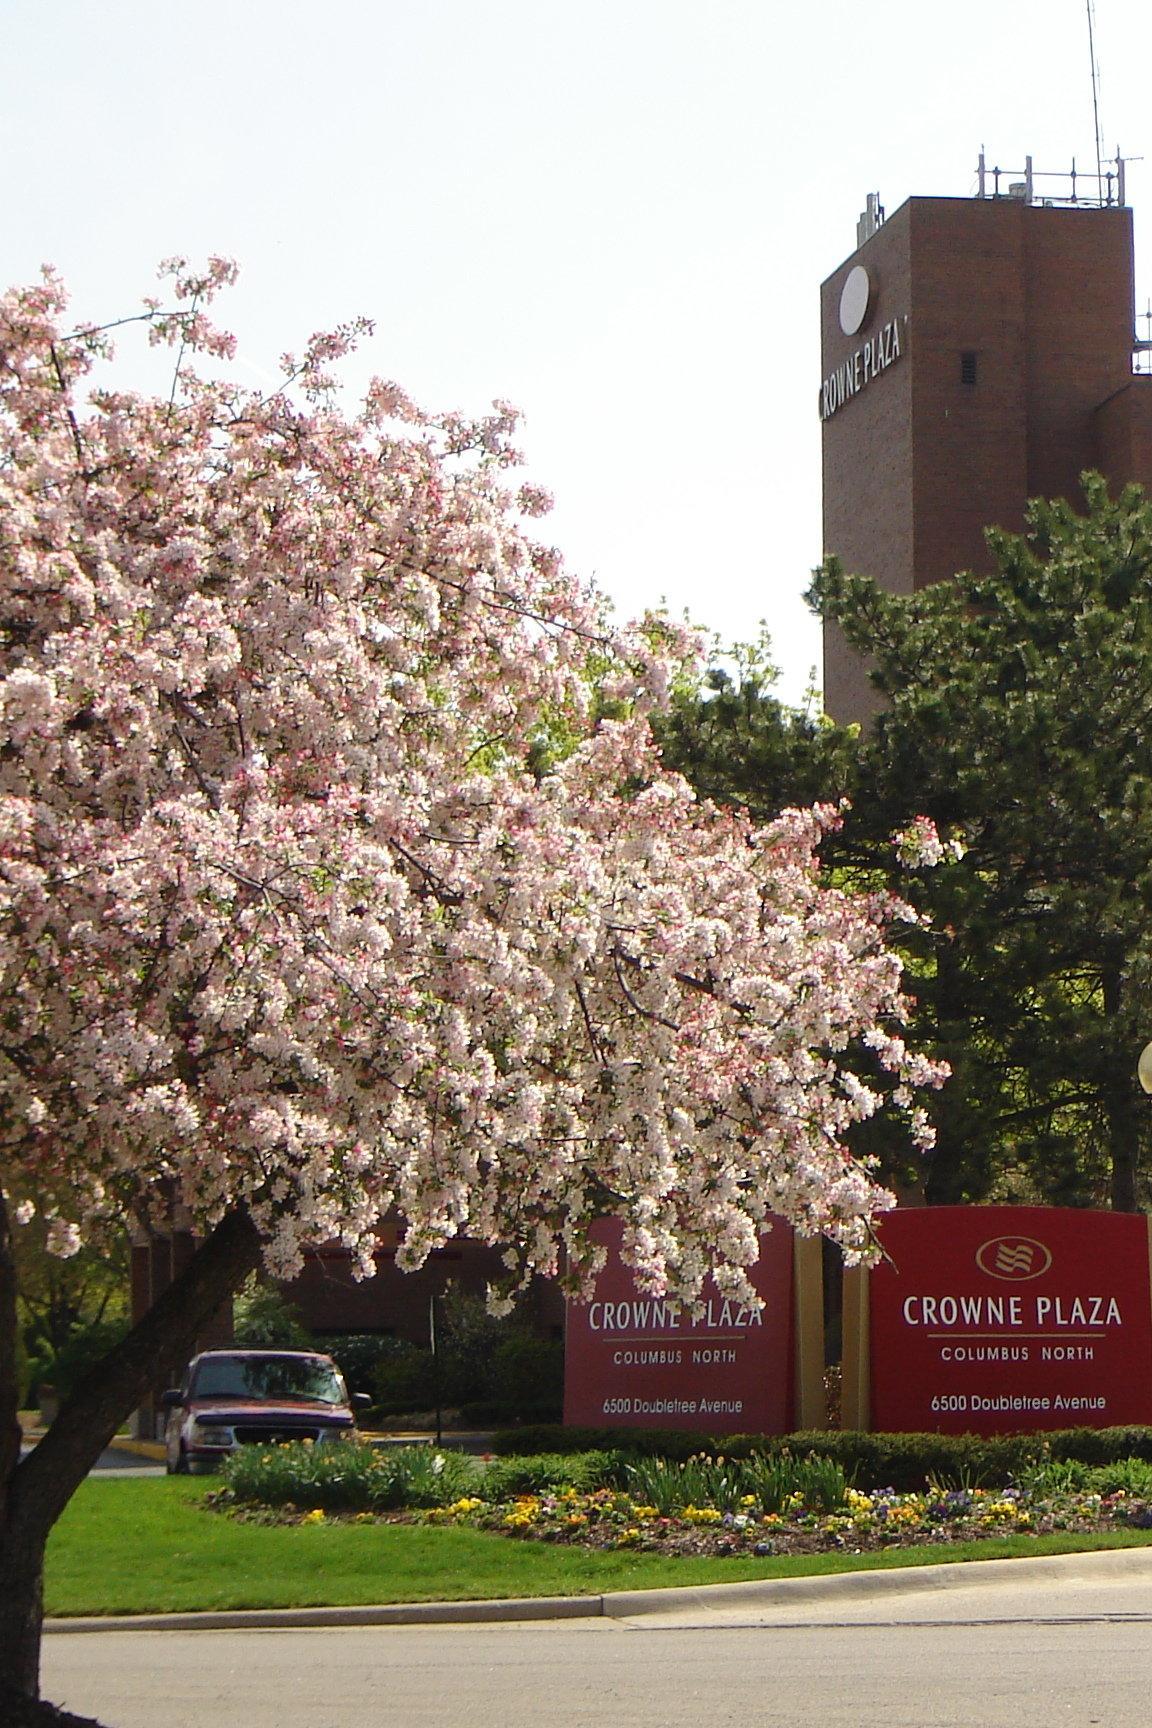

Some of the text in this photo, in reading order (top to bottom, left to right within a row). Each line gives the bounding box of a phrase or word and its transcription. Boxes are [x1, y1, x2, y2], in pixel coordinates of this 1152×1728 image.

[818, 318, 901, 422] CROWNE PLAZA
[903, 1296, 1122, 1326] CROWNE PLAZA
[613, 1349, 737, 1365] COLUMBUS NORTH
[941, 1347, 1094, 1361] COLUMBUS NORTH
[602, 1397, 744, 1414] 6500 Doubletree Avenue
[931, 1393, 1107, 1411] 6500 Doubletree Avenue
